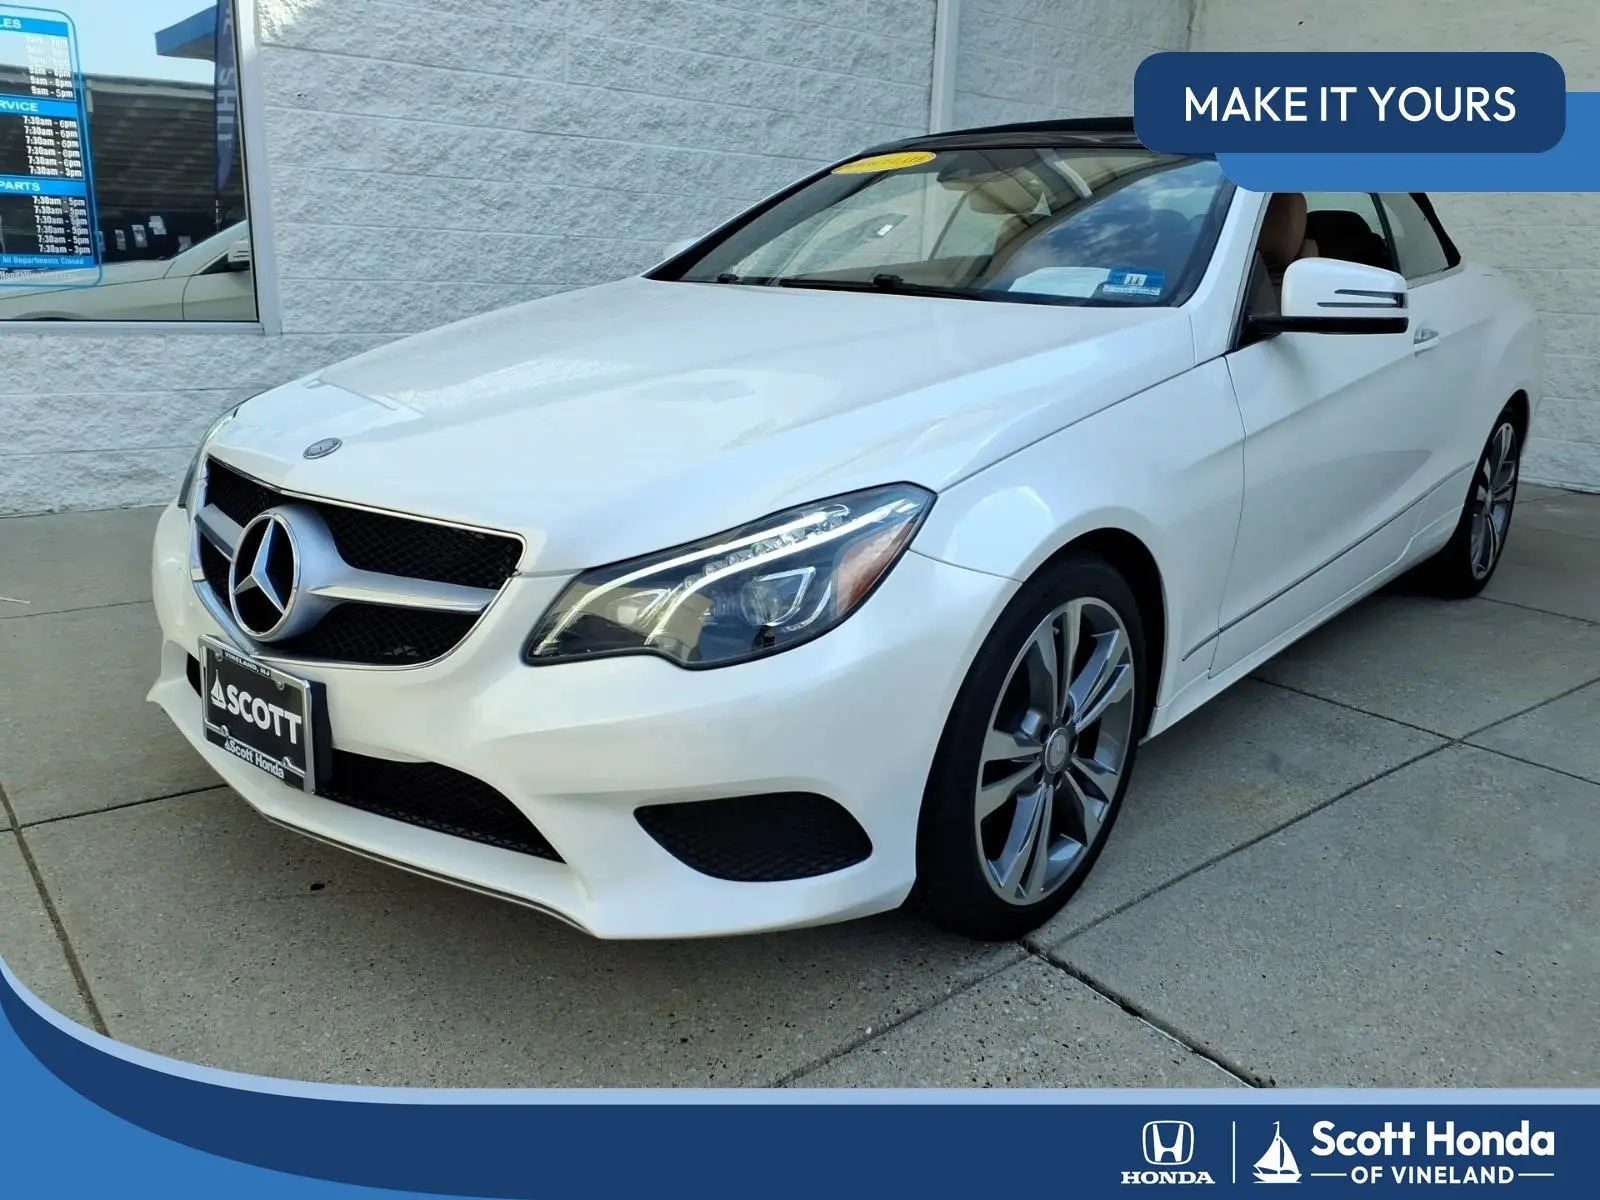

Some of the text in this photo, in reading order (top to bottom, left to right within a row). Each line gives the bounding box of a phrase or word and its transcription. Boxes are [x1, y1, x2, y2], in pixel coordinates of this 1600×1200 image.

[56, 88, 73, 98] 5pm
[22, 115, 53, 126] 7:30am
[24, 125, 54, 136] 7:30am
[25, 135, 55, 146] 7:30am
[26, 145, 56, 156] 7:30am
[28, 155, 58, 166] 7:30am
[29, 165, 59, 176] 7:30am
[65, 167, 82, 177] 3pm
[32, 195, 62, 205] 7:30am
[34, 205, 63, 215] 7:30am
[35, 215, 64, 224] 7:30am
[36, 224, 65, 234] 7:30am
[37, 234, 66, 244] 7:30am
[39, 244, 67, 253] 7:30am
[13, 256, 59, 265] Departments
[60, 257, 84, 265] Closed
[226, 684, 302, 744] SCOTT
[229, 740, 285, 779] Scott Honda
